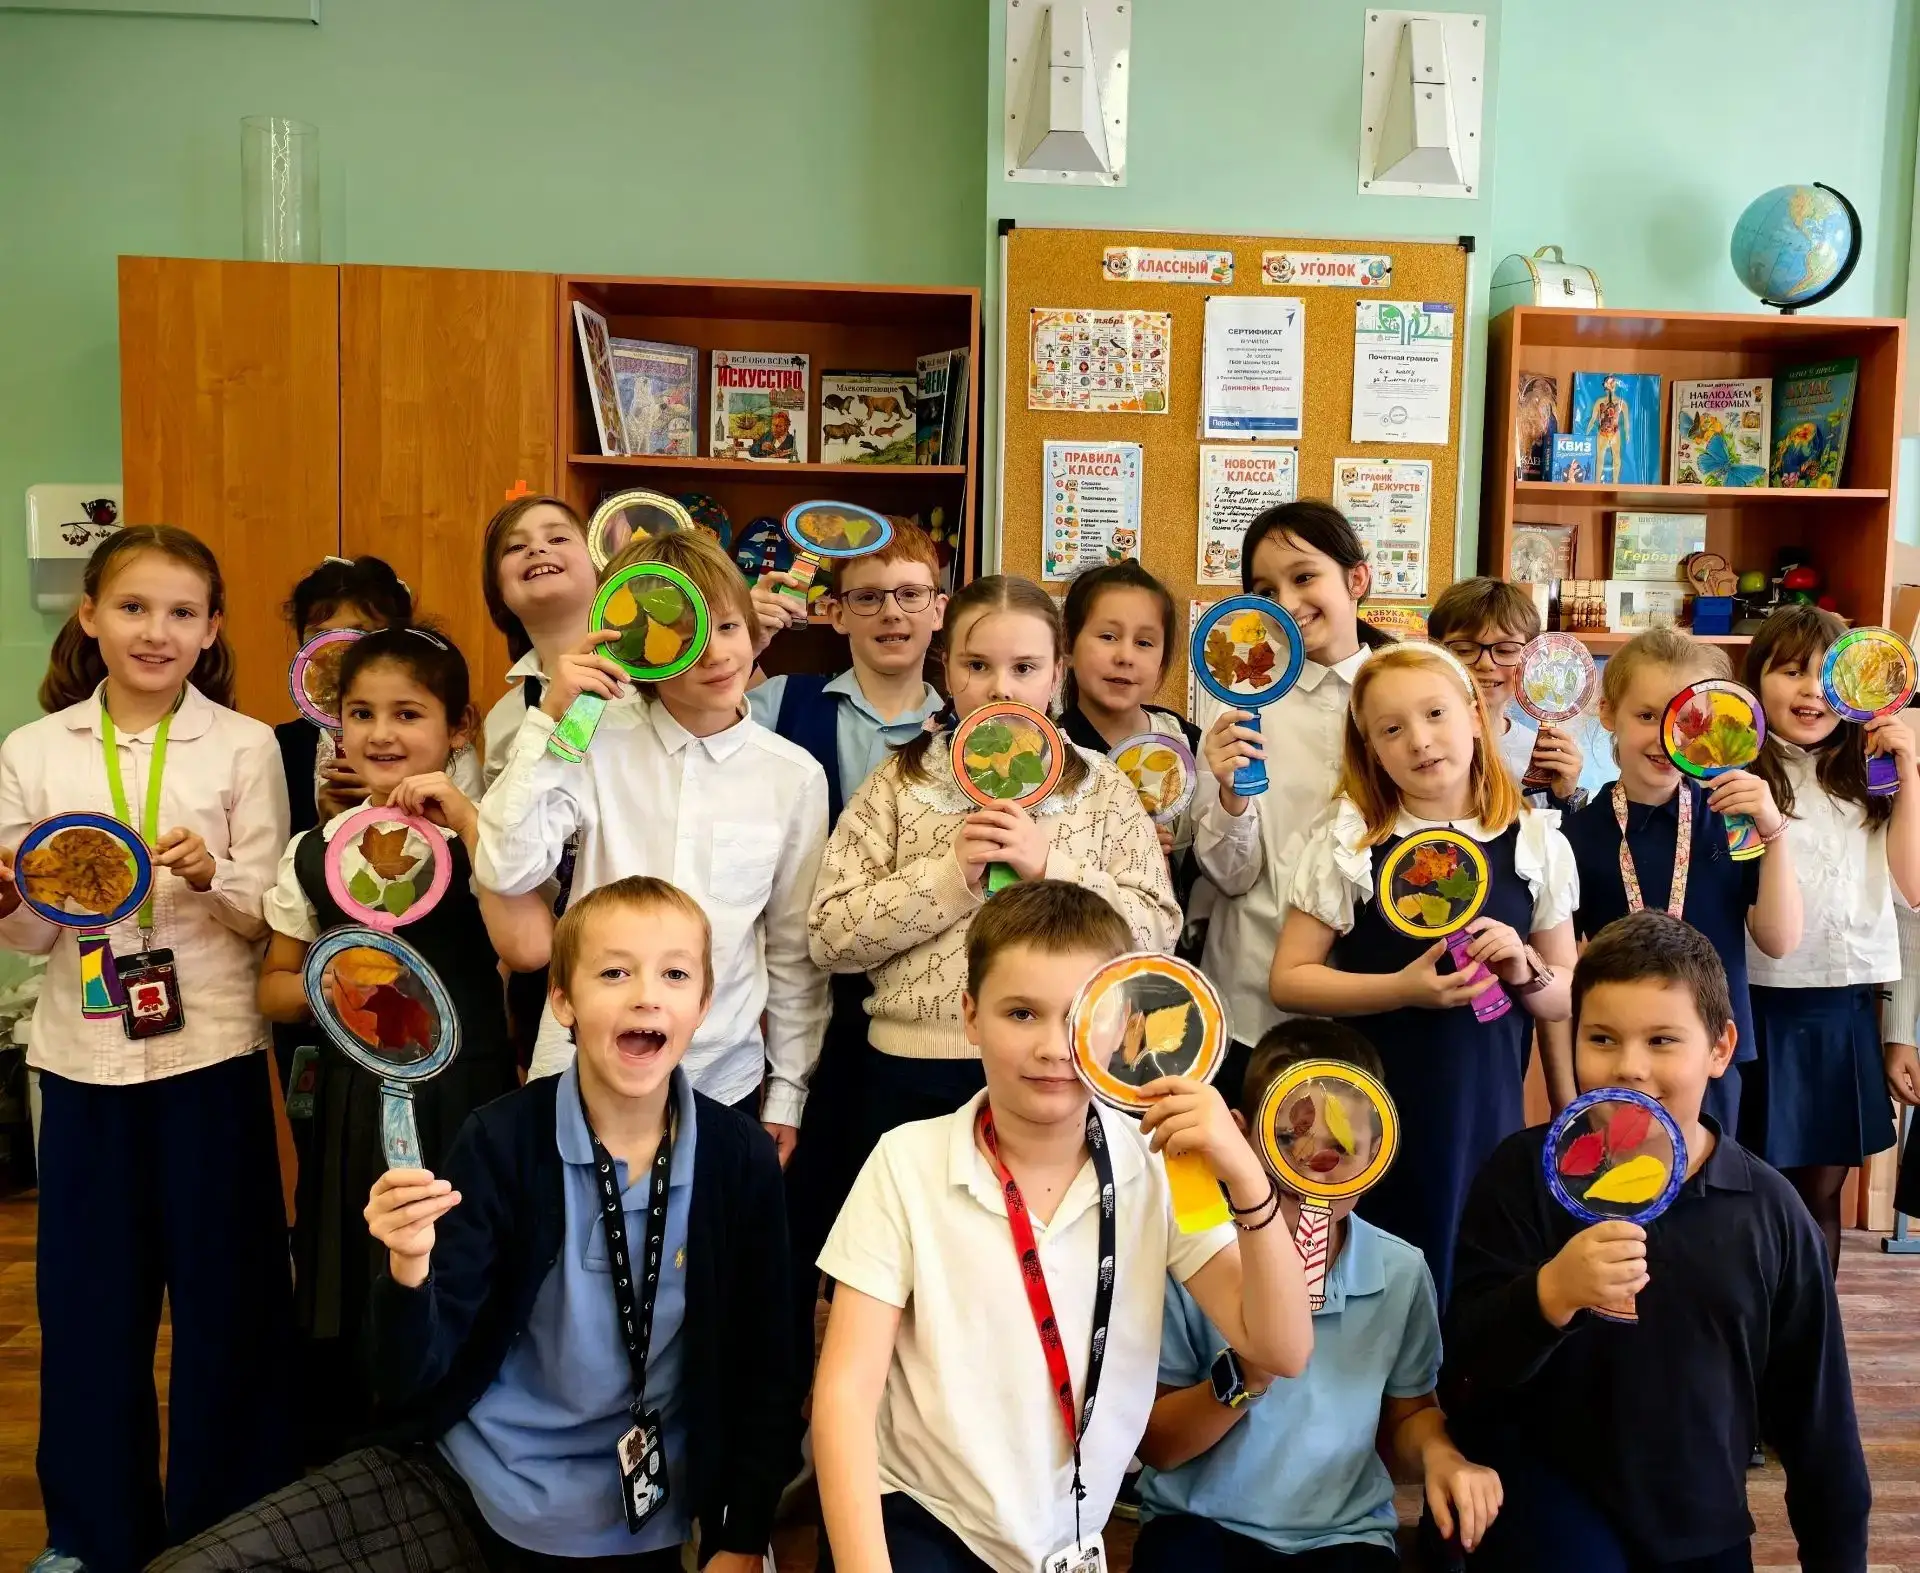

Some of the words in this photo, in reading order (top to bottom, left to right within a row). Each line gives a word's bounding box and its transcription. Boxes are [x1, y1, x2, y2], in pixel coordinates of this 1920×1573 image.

[1137, 259, 1208, 274] КЛАССНЫЙ
[1300, 262, 1355, 277] УГОЛОК
[1228, 328, 1283, 336] СЕРТИФИКАТ
[749, 356, 766, 364] ОБО
[1368, 353, 1405, 361] Почетная
[1406, 355, 1439, 363] грамота
[717, 367, 803, 390] ИСКУССТВО
[836, 383, 899, 394] Млекопитающие
[1262, 384, 1290, 392] Первых
[1689, 390, 1752, 400] НАБЛЮДАЕМ
[1690, 400, 1751, 409] НАСЕКОМЫХ
[1212, 419, 1240, 428] Первые
[1557, 440, 1592, 453] КВИЗ
[1064, 452, 1122, 464] ПРАВИЛА
[1224, 459, 1276, 470] НОВОСТИ
[1068, 464, 1119, 477] КЛАССА
[1226, 471, 1275, 482] КЛАССА
[1360, 473, 1393, 482] ГРАФИК
[1371, 483, 1420, 493] ДЕЖУРСТВ
[1623, 549, 1683, 563] Гербар
[1366, 609, 1405, 618] АЗБУКА
